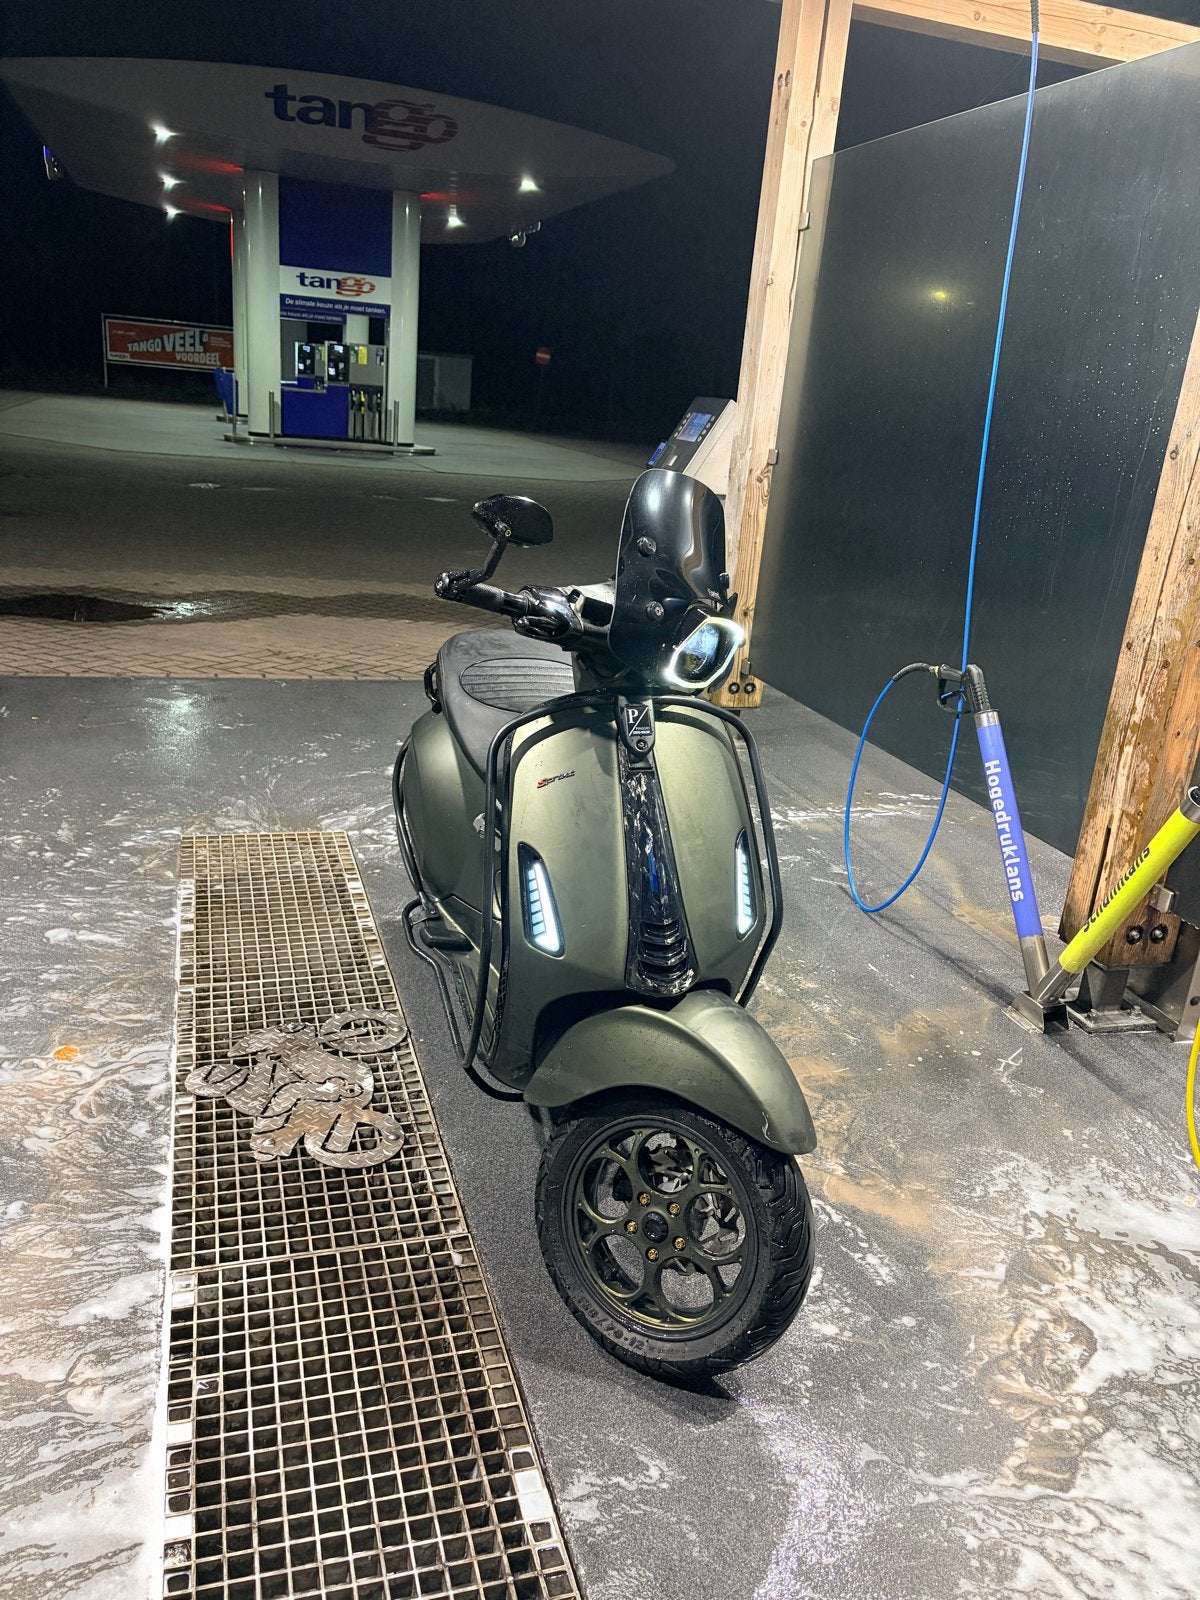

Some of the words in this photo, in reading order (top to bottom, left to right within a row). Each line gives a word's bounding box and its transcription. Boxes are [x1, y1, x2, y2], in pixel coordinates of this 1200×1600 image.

[265, 84, 459, 152] tango
[296, 272, 376, 297] tango
[285, 297, 294, 305] De
[295, 299, 316, 307] slimste
[316, 301, 333, 309] keuze
[127, 338, 161, 352] TANGO
[163, 328, 205, 352] VEEL
[175, 352, 222, 365] VOORDEEL
[627, 708, 639, 724] P
[984, 759, 1025, 902] Hogedruklans
